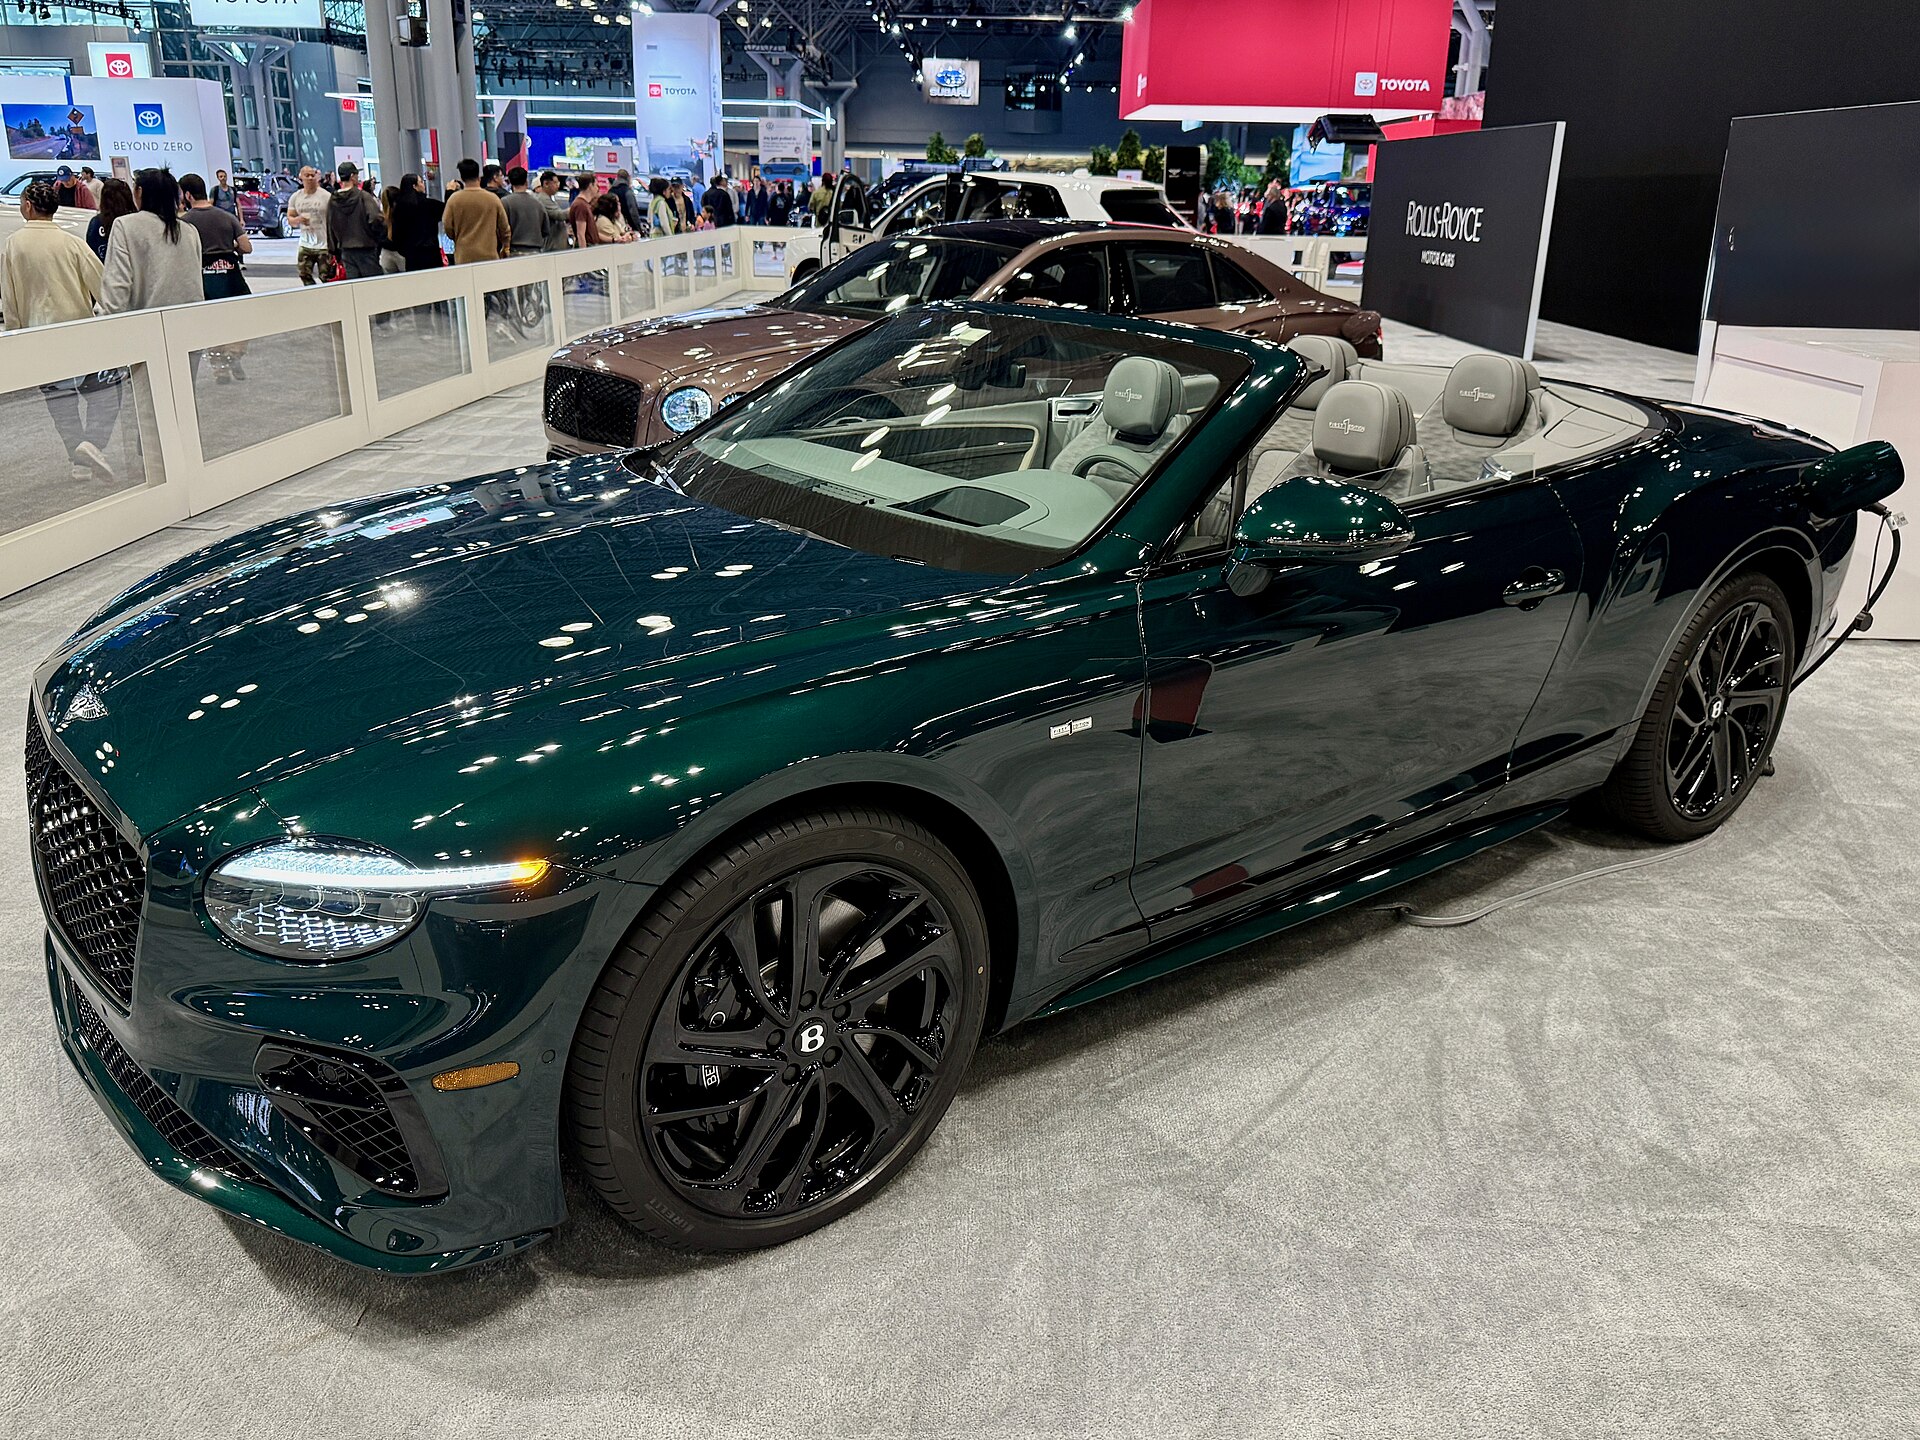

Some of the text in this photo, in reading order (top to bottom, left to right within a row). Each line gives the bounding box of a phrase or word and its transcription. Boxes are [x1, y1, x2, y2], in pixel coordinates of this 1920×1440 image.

[664, 87, 697, 96] TOYOTA
[1380, 78, 1430, 92] TOYOTA
[929, 87, 971, 98] SUBARU
[113, 141, 193, 152] BEYOND ZERO
[1405, 200, 1485, 243] ROLLS-ROYCE
[1420, 250, 1456, 268] MOTOR CARS
[800, 1024, 825, 1053] B
